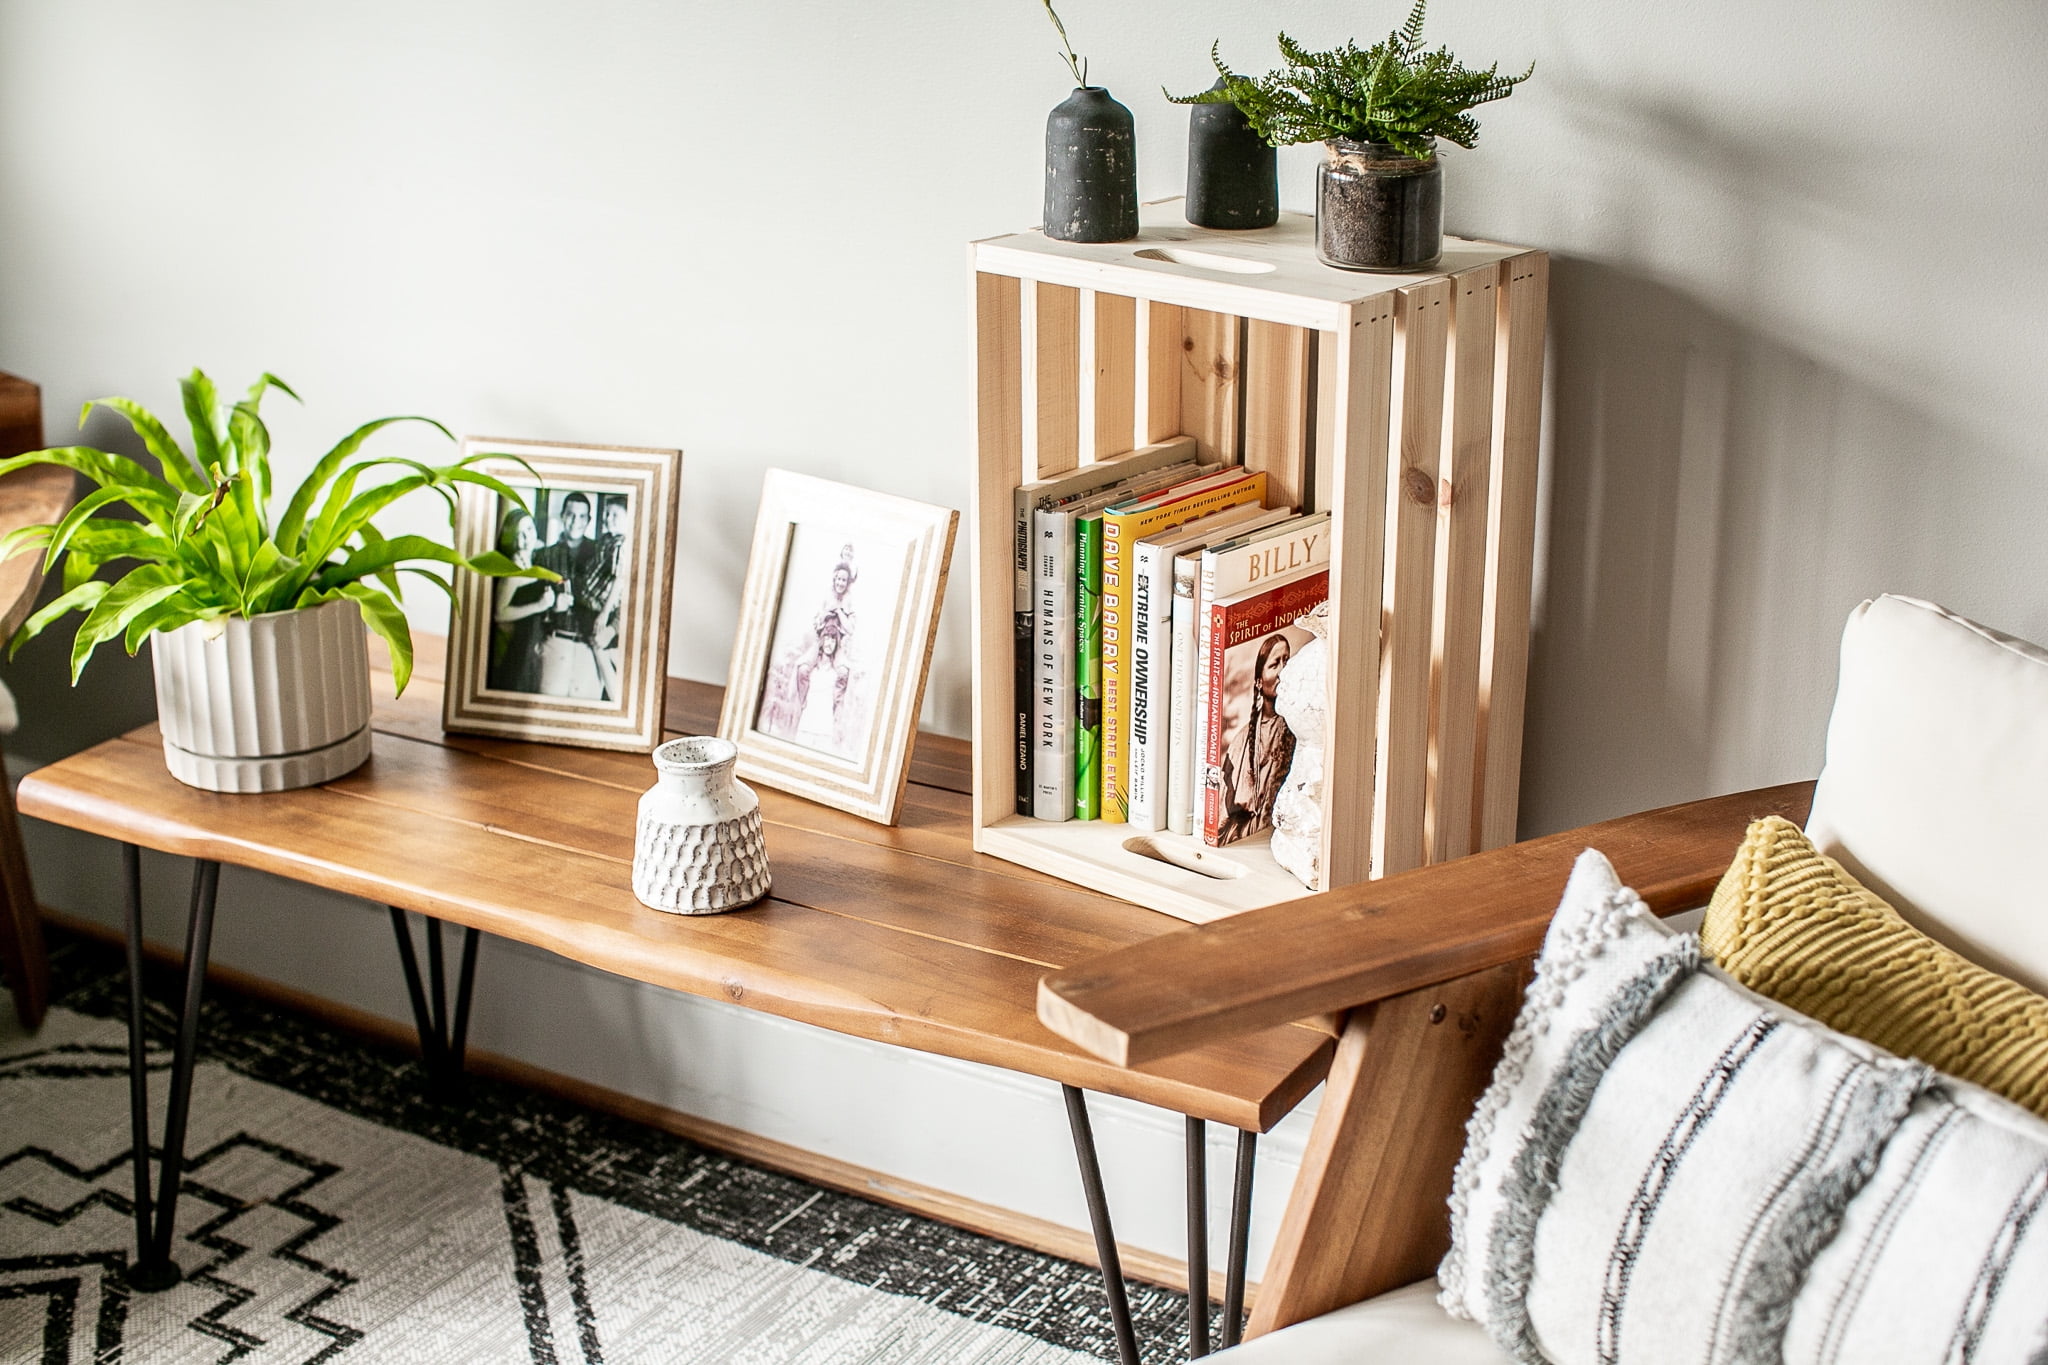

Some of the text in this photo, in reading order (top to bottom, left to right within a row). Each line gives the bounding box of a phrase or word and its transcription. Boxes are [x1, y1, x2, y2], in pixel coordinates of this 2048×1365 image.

[1140, 483, 1256, 526] NEW YORK TIMES BESTSELLING AUTHOR
[1078, 532, 1087, 575] Planning
[1248, 534, 1318, 582] BILLY
[1078, 577, 1087, 620] Learning
[1103, 521, 1120, 674] DAVE BARRY
[1229, 604, 1311, 645] SPIRIT OF INDIAN
[1236, 619, 1249, 629] THE
[1042, 589, 1054, 748] HUMANS OF NEW YORK
[1134, 574, 1149, 746] EXTREME OWNERSHIP
[1212, 648, 1221, 676] SPIRIT
[1212, 676, 1218, 686] OF
[1107, 679, 1118, 714] BEST.
[1211, 687, 1220, 723] INDIAN
[1019, 712, 1027, 771] DANIEL LEZANO
[1106, 717, 1117, 762] STATE.
[1209, 724, 1219, 763] WOMEN
[1106, 765, 1117, 803] EVER.
